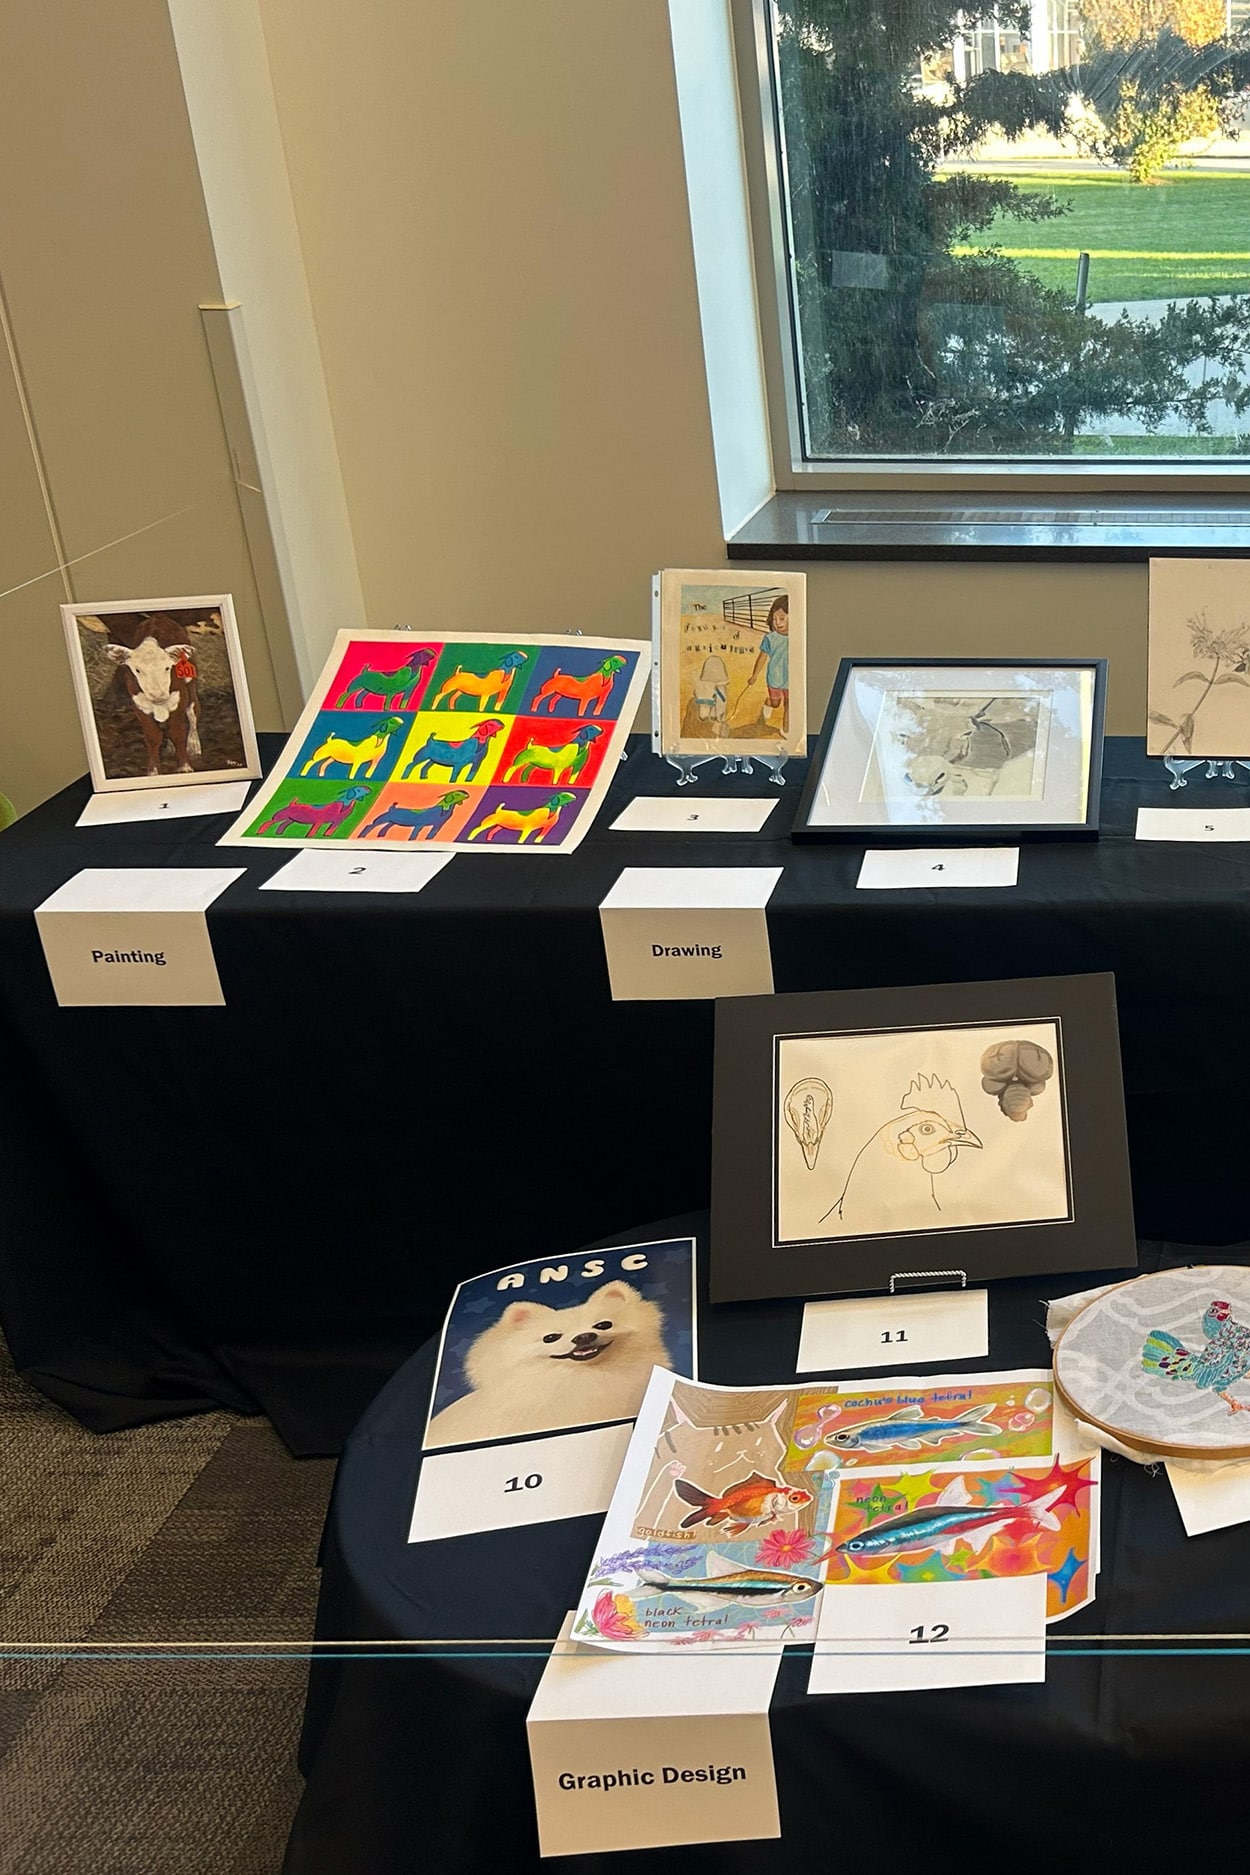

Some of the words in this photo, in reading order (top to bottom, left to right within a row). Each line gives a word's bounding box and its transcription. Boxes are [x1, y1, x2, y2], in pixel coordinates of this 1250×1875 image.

[159, 802, 170, 810] 1
[349, 866, 367, 875] 2
[91, 949, 167, 966] Painting
[651, 943, 723, 960] Drawing
[880, 1330, 908, 1344] 11
[896, 1395, 926, 1404] blue
[932, 1389, 973, 1403] tetra!
[503, 1473, 543, 1493] 10
[856, 1496, 887, 1504] neon
[637, 1526, 697, 1539] goldfish!
[645, 1606, 683, 1617] black
[644, 1618, 676, 1629] neon
[684, 1613, 729, 1627] tetra!
[908, 1624, 950, 1645] 12
[557, 1767, 655, 1793] Graphic
[661, 1764, 748, 1788] Design
